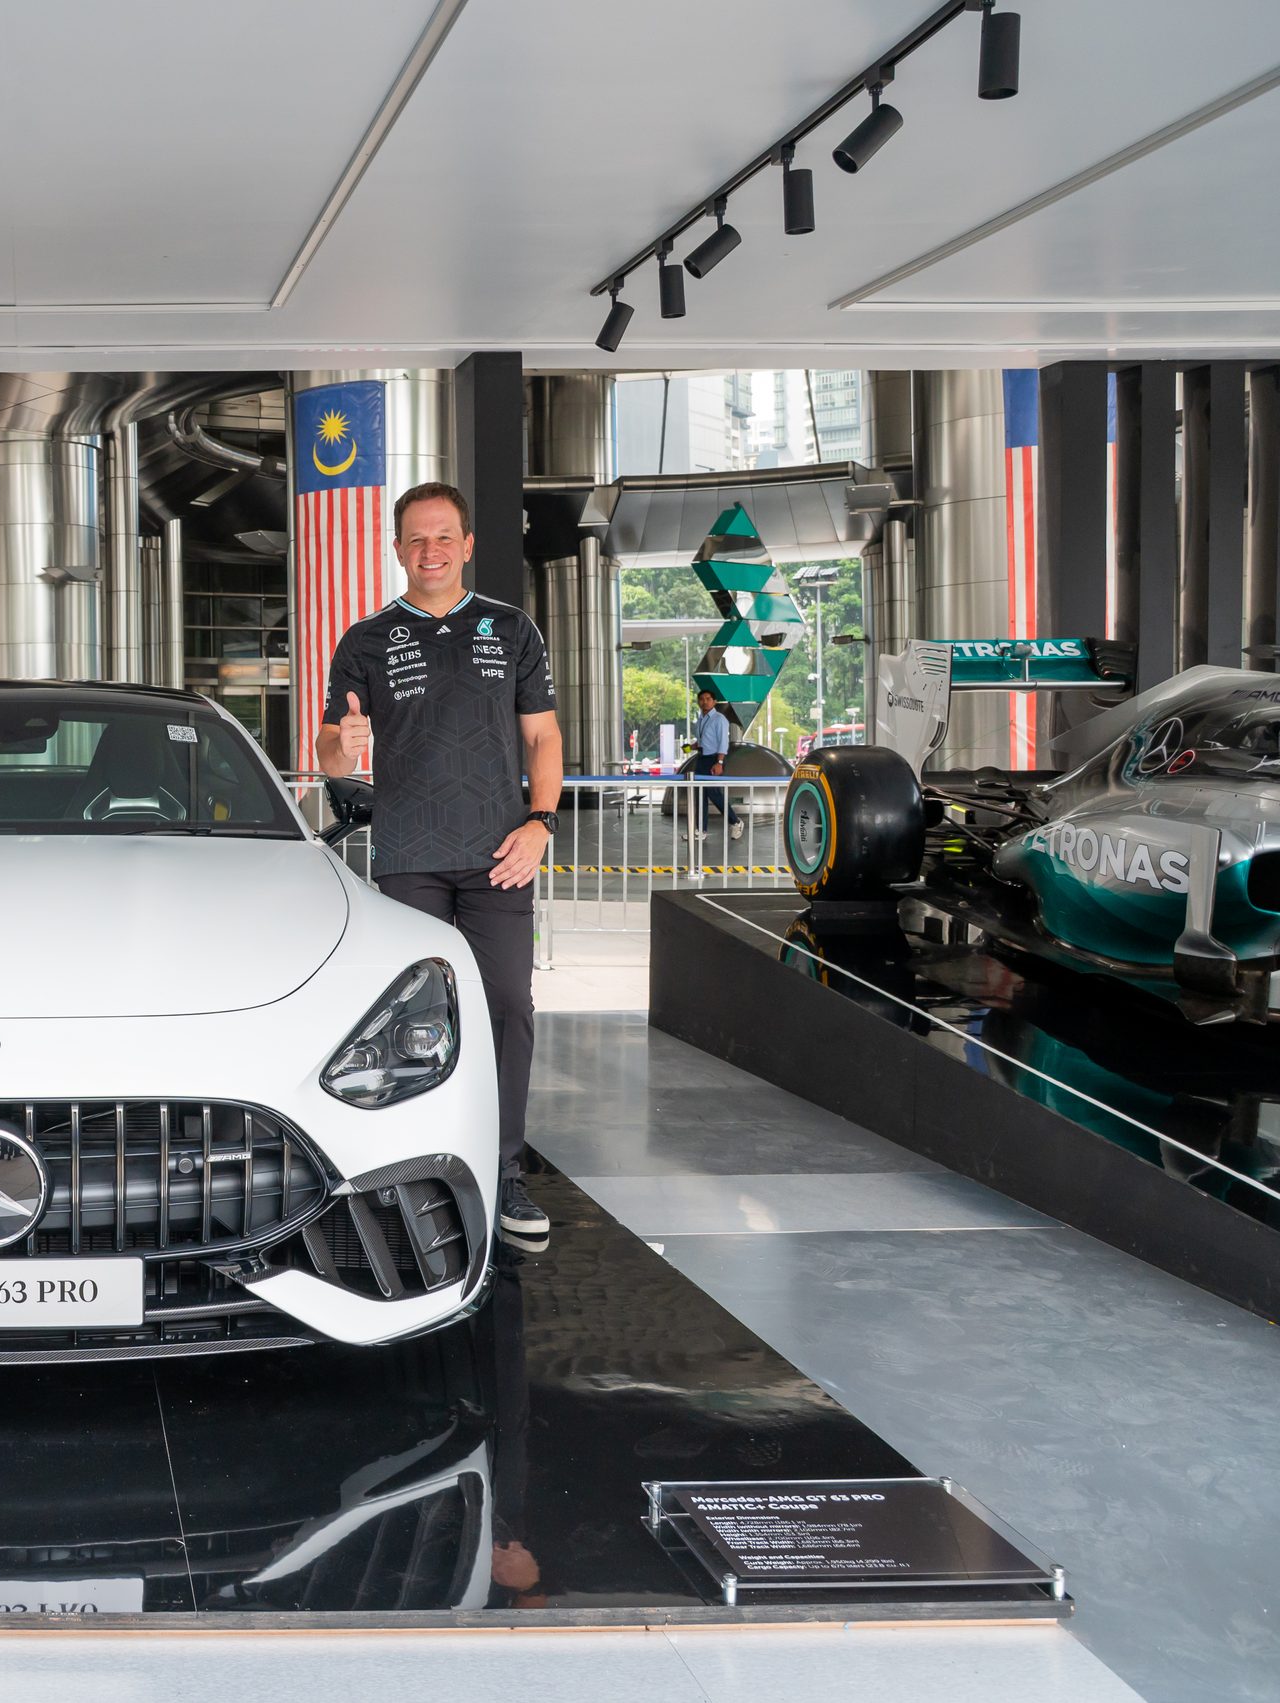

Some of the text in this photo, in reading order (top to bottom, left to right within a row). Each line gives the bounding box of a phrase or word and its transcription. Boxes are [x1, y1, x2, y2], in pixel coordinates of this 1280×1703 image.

[472, 645, 504, 655] INEOS
[400, 650, 421, 662] UBS
[481, 669, 505, 679] HPE
[36, 1279, 99, 1303] PRO
[691, 1495, 805, 1503] Mercedes-AMG
[698, 1503, 766, 1511] 4MATIC+
